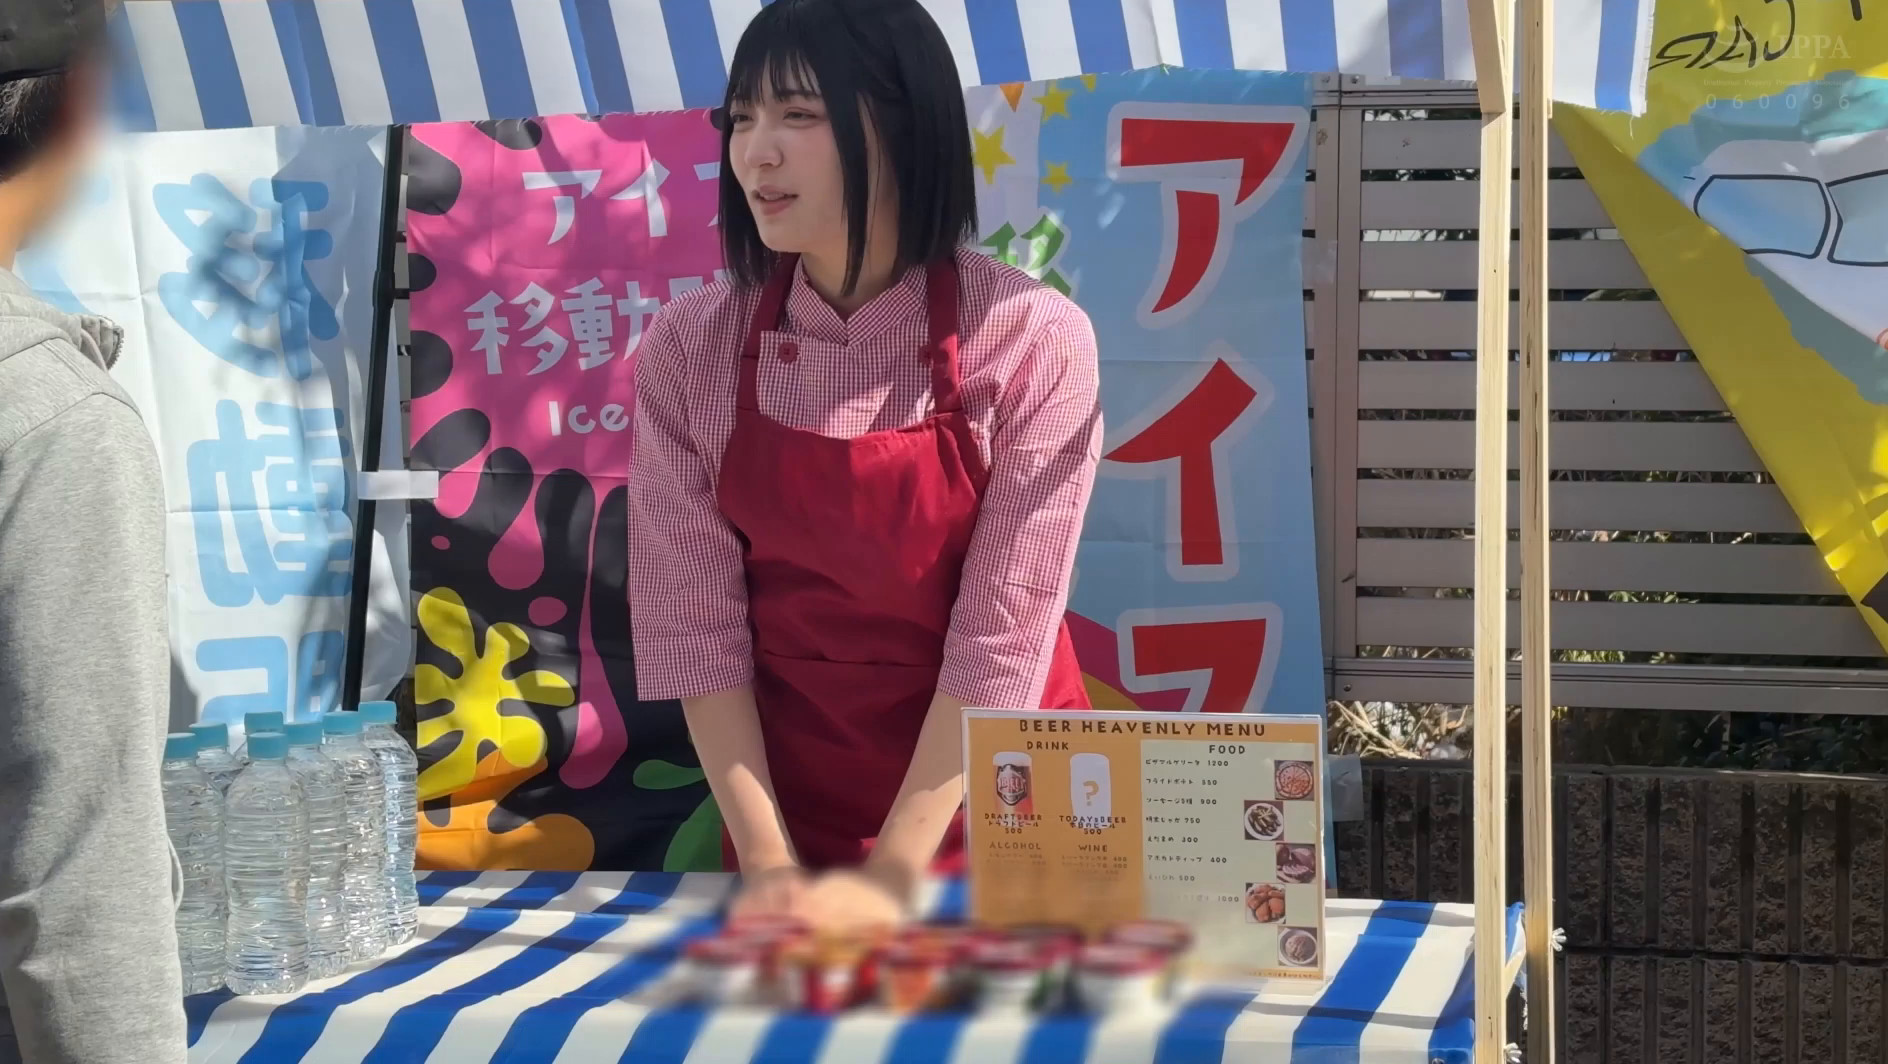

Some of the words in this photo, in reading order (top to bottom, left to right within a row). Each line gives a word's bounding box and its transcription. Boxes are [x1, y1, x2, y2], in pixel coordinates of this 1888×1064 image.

[548, 400, 630, 437] Ice
[1019, 720, 1072, 733] BEER
[1082, 721, 1196, 735] HEAVENLY
[1206, 723, 1265, 737] MENU
[1026, 741, 1069, 750] DRINK
[1209, 744, 1246, 754] FOOD
[1185, 817, 1201, 825] 750
[989, 841, 1041, 850] ALCOHOL
[1078, 844, 1108, 853] WINE
[1217, 895, 1240, 903] 1000
